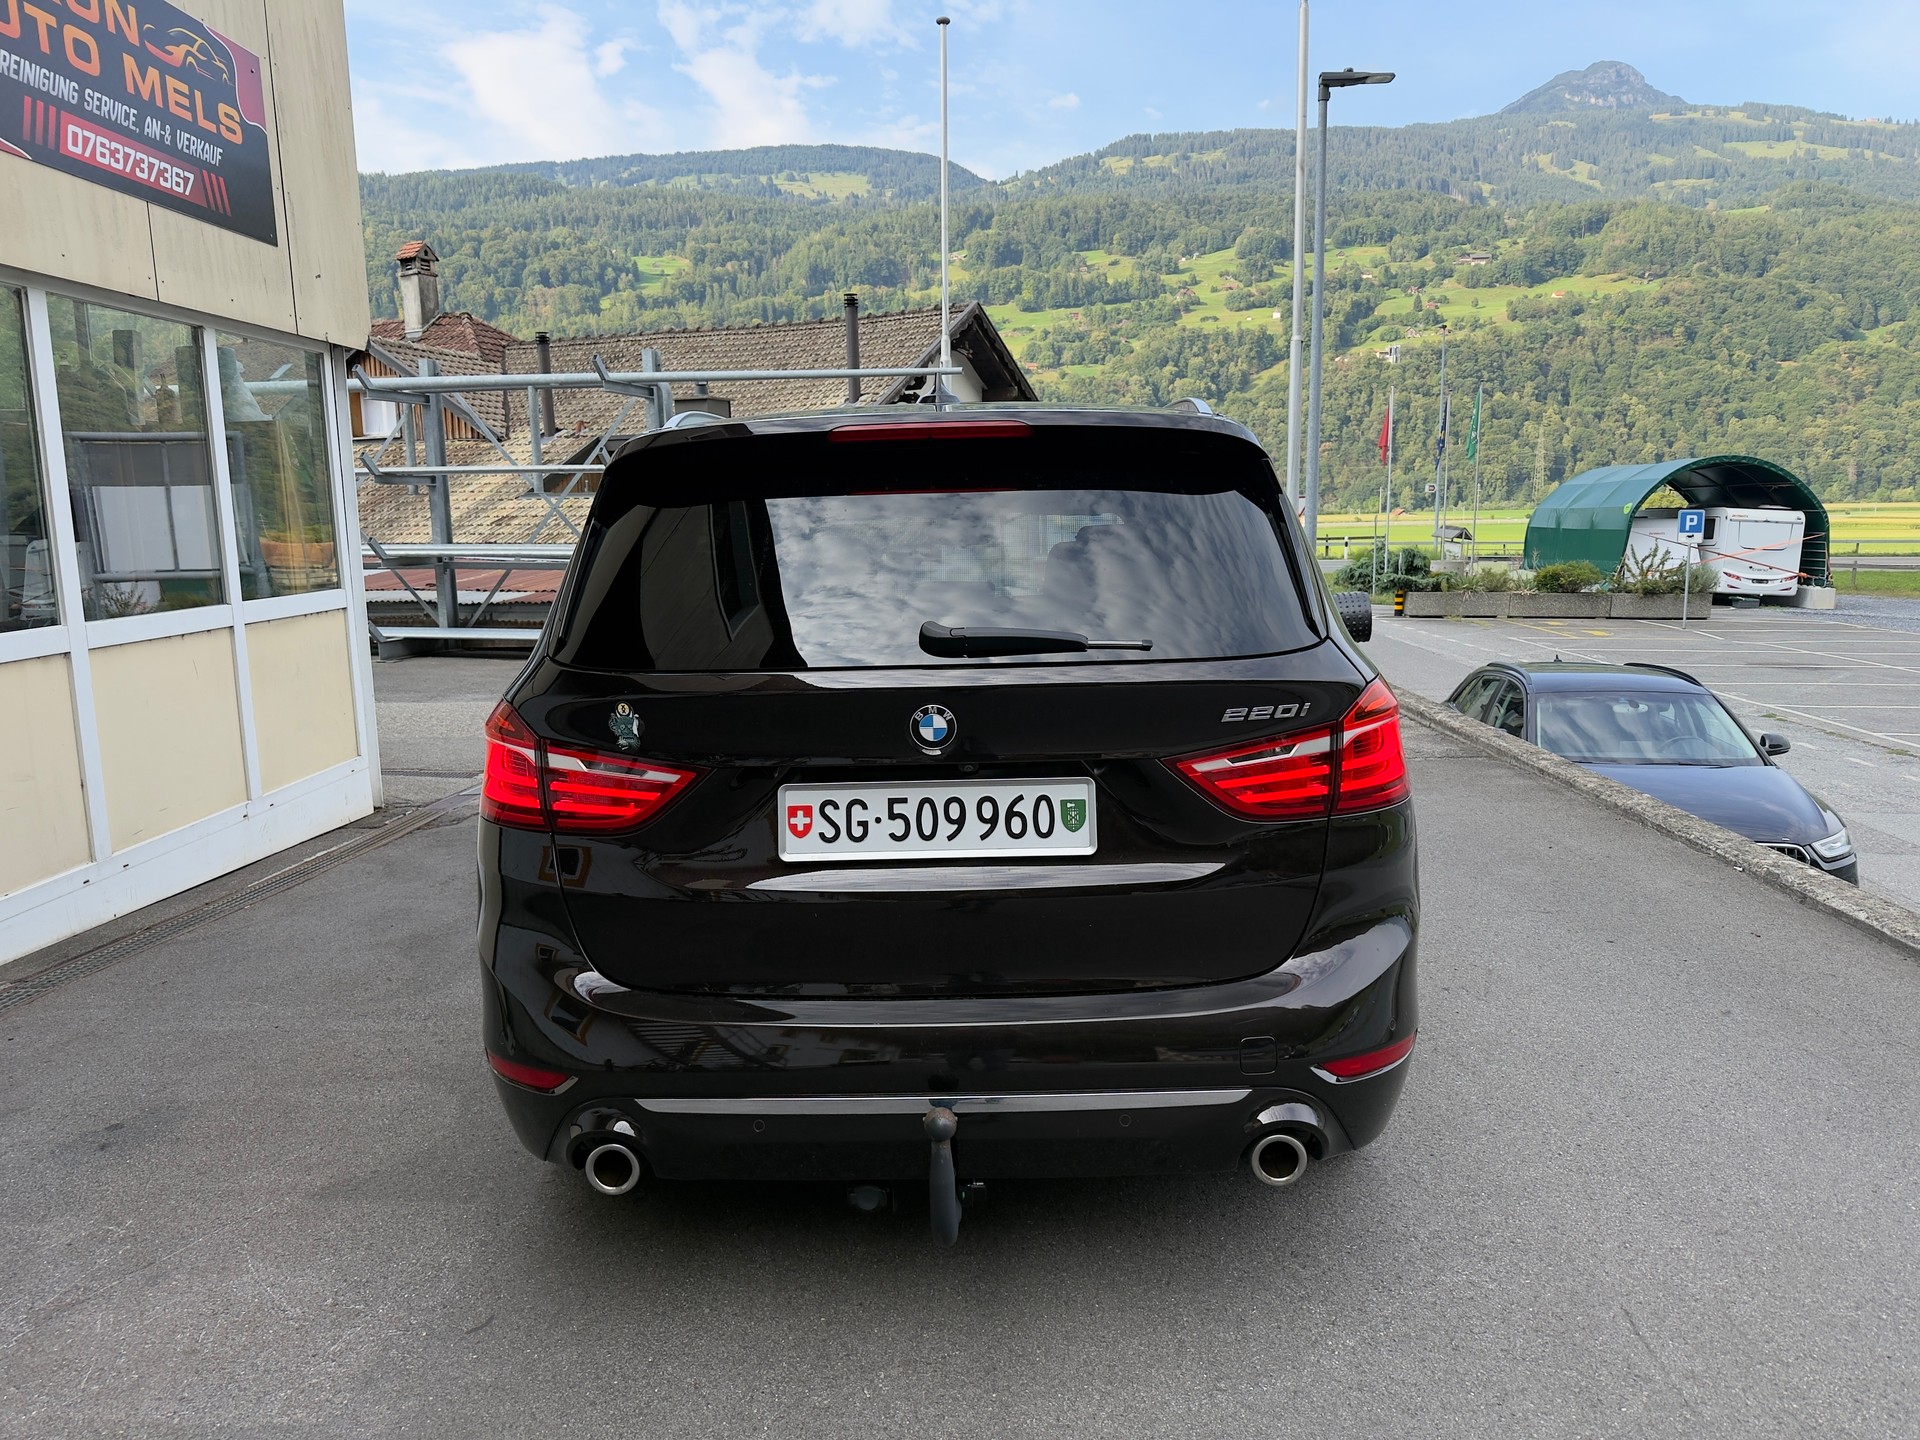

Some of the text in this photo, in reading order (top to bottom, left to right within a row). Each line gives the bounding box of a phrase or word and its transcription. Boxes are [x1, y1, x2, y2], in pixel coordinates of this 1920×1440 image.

[0, 48, 79, 105] REINIGUNG
[176, 128, 224, 167] VERKAUF
[122, 52, 243, 145] MELS
[67, 126, 195, 196] 0763737367
[1685, 514, 1698, 531] P
[914, 706, 953, 722] BMW
[1221, 702, 1312, 723] 220i
